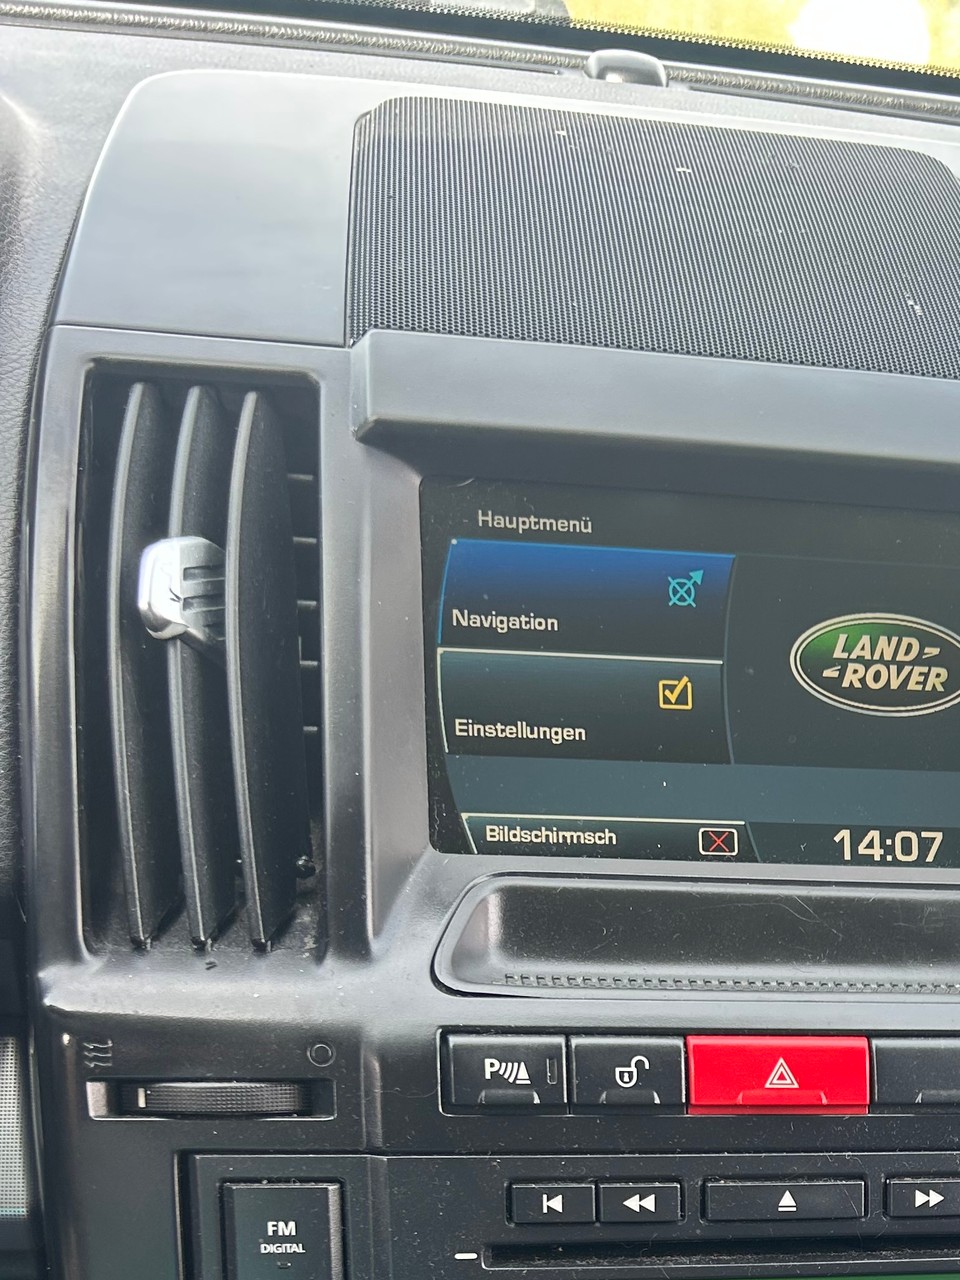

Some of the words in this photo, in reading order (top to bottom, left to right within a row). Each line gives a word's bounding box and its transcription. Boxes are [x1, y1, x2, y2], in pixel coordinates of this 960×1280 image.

[478, 509, 592, 534] Hauptmenü
[452, 608, 558, 634] Navigation
[454, 718, 586, 745] Einstellungen
[485, 824, 617, 846] Bildschirmsch
[833, 829, 943, 863] 14:07
[267, 1220, 296, 1236] FM
[260, 1243, 306, 1254] DIGITAL
